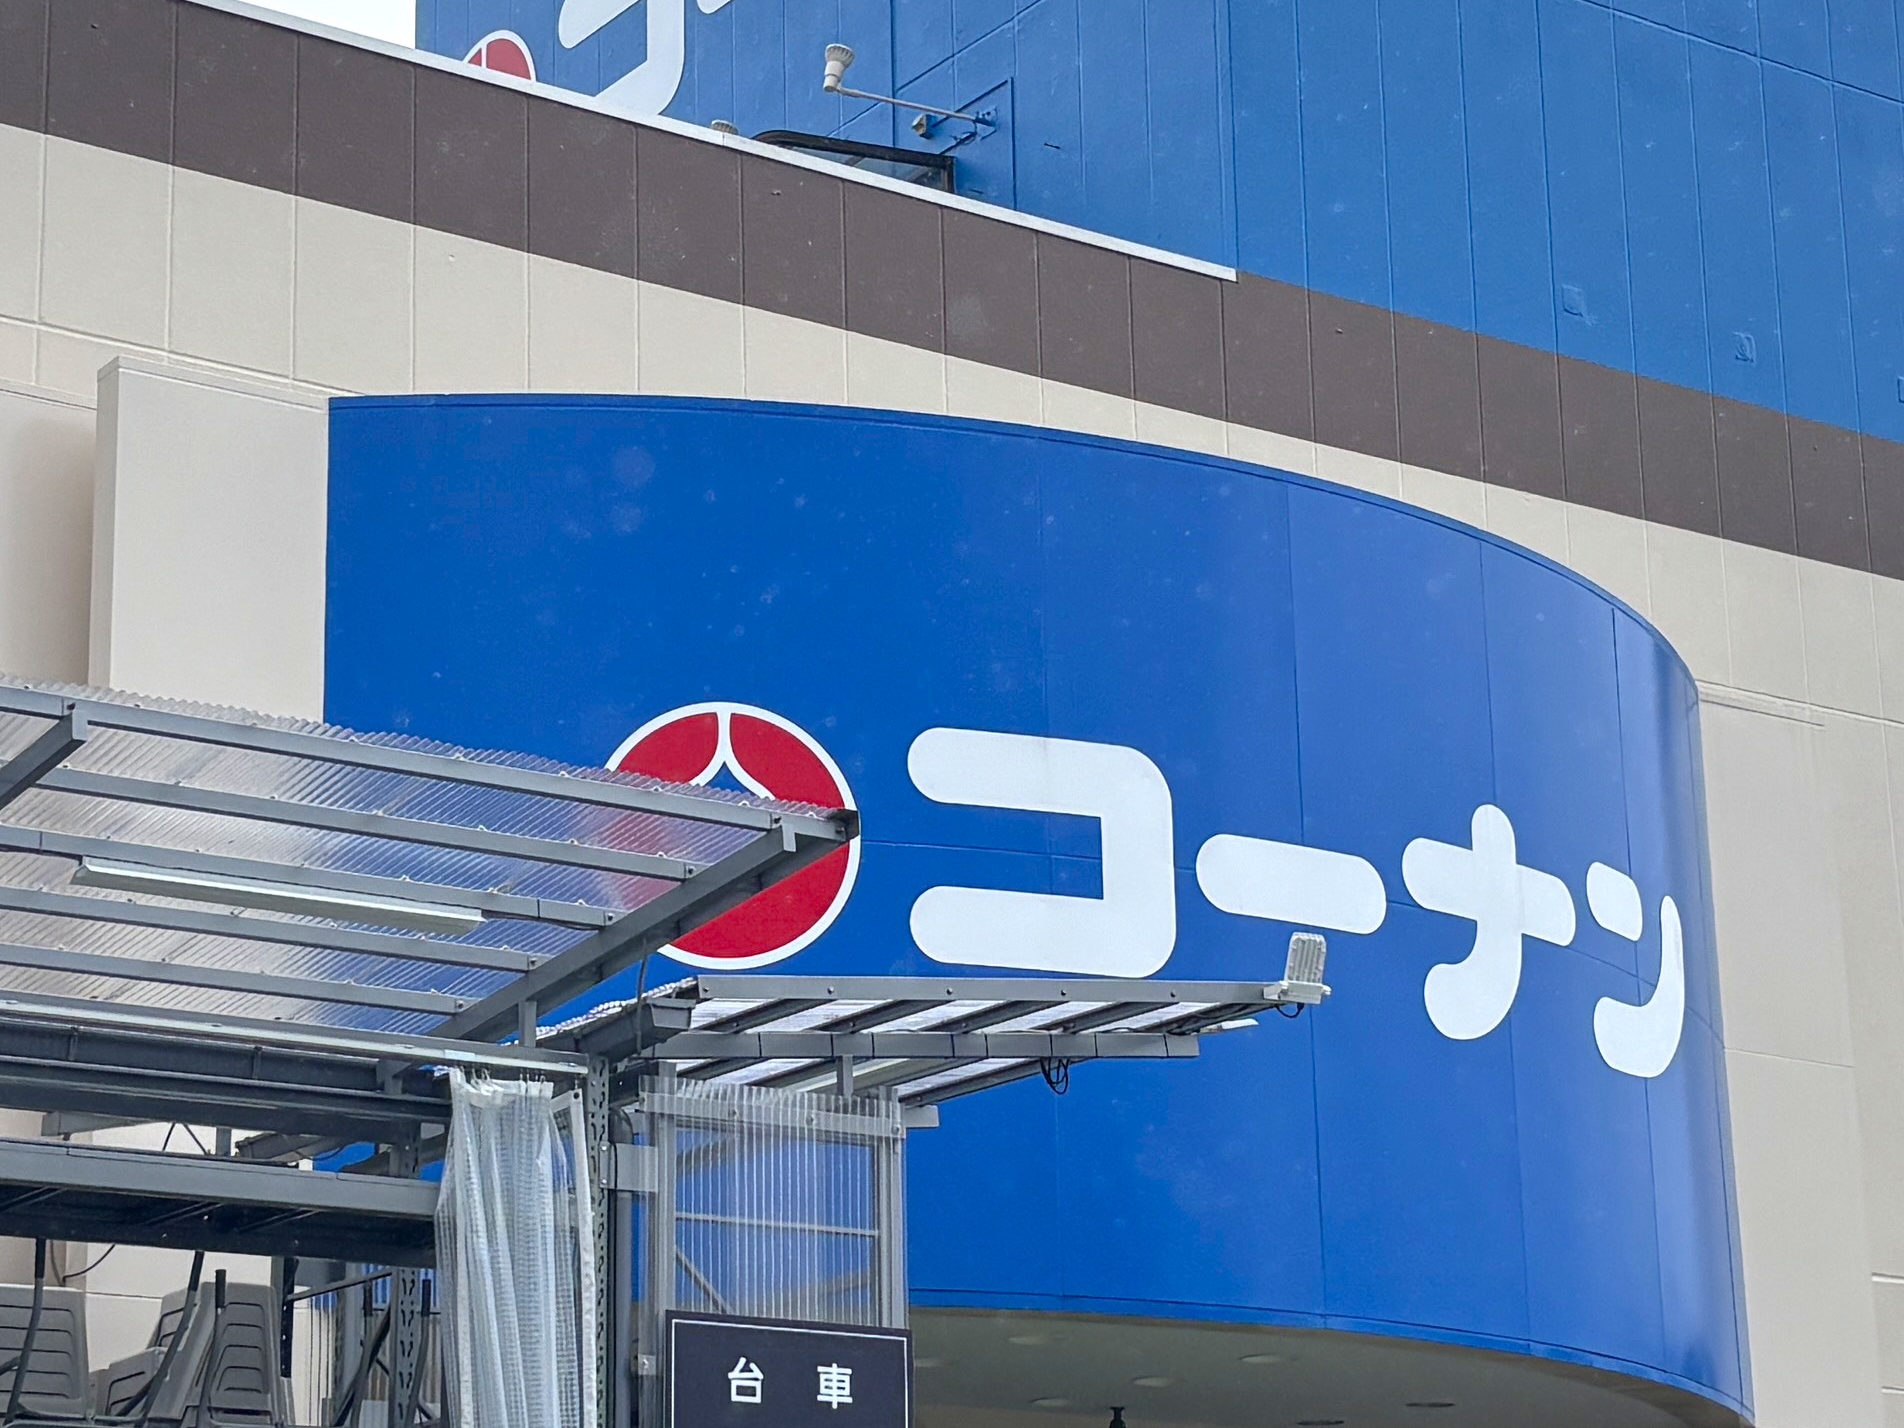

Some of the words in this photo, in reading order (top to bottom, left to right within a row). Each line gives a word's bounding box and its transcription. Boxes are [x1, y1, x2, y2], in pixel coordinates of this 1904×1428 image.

[907, 726, 1685, 1078] コーナン
[728, 1357, 853, 1409] 台車
